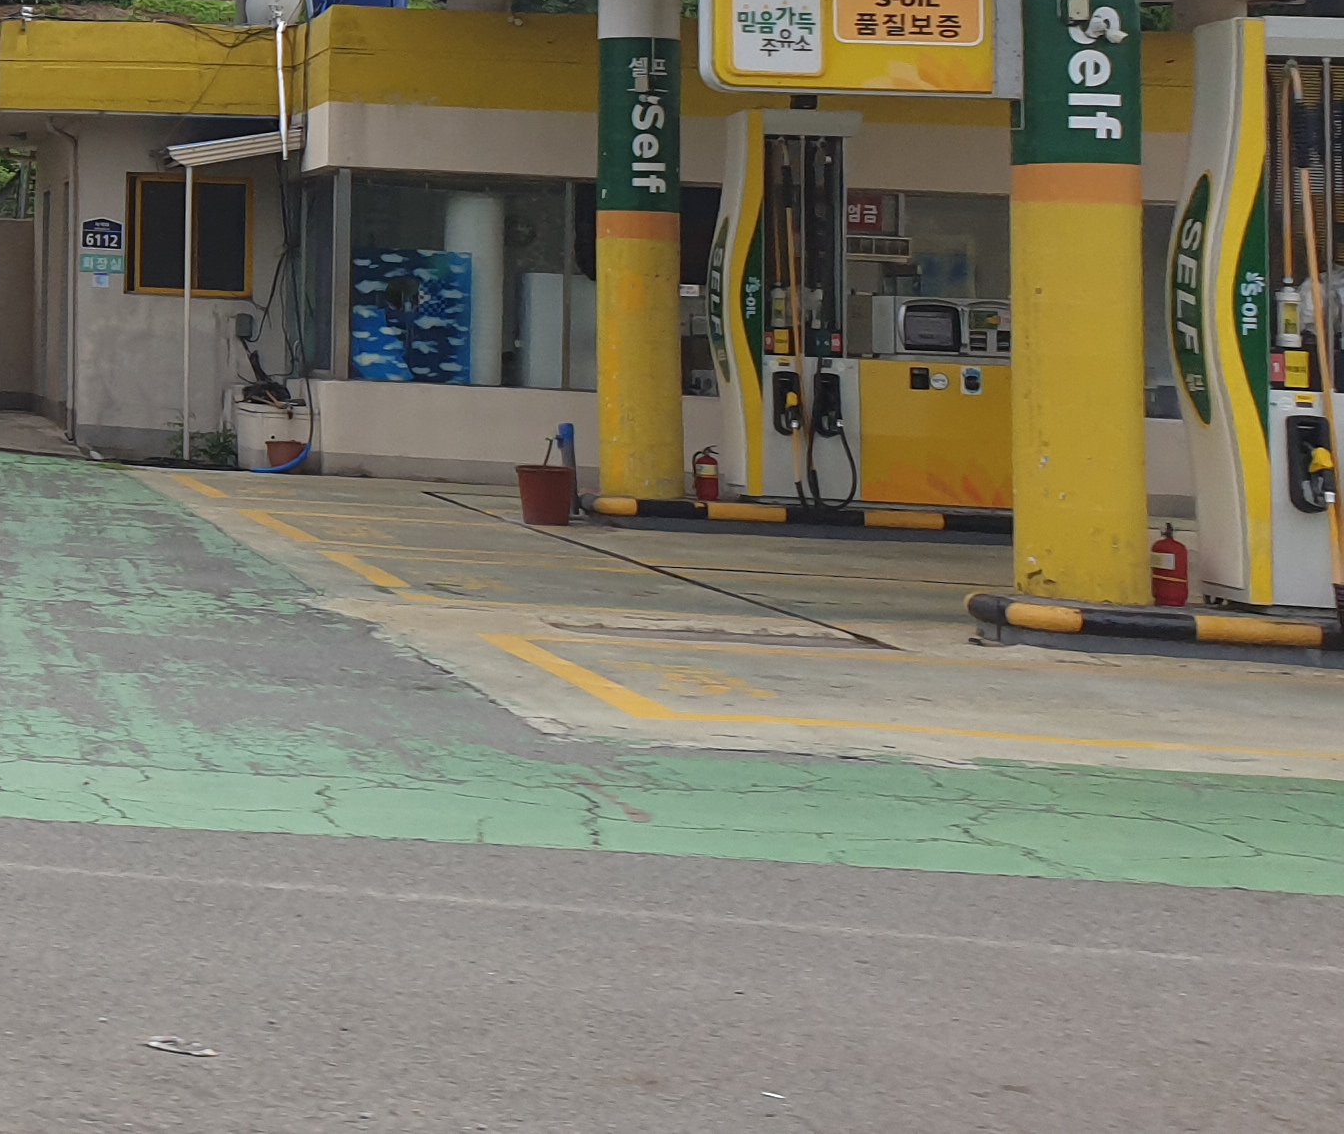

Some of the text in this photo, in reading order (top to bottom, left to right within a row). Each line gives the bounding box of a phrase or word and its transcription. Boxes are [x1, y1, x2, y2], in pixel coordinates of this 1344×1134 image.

[737, 6, 816, 36] 믿음가득
[854, 12, 962, 39] 품질보증
[759, 28, 814, 57] 주유소
[630, 101, 666, 194] Self
[85, 233, 119, 247] 6112
[1176, 218, 1202, 355] SELF
[1240, 283, 1260, 336] S-OIL
